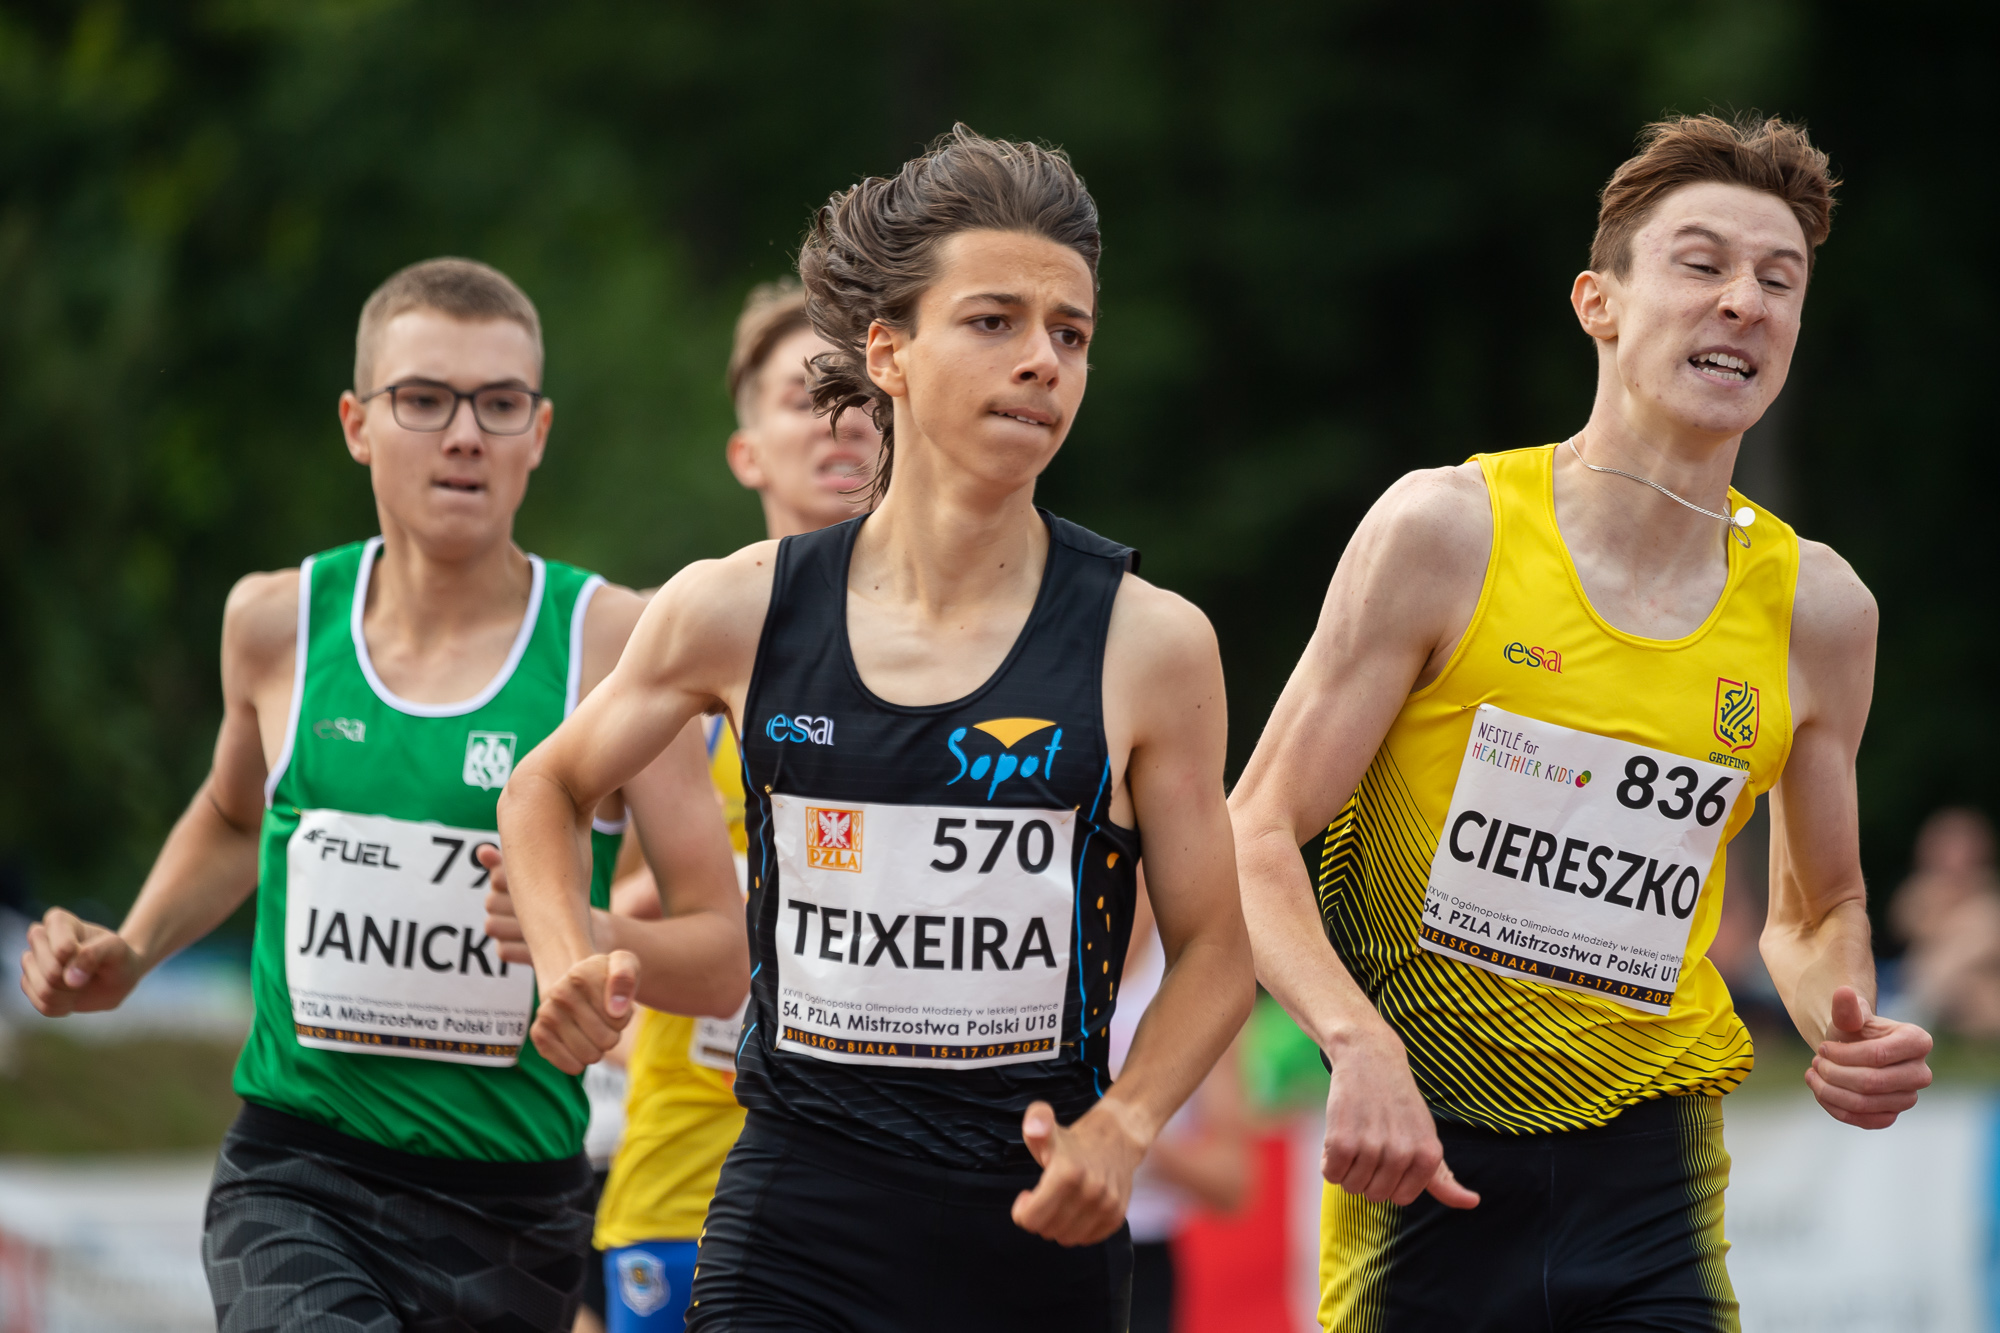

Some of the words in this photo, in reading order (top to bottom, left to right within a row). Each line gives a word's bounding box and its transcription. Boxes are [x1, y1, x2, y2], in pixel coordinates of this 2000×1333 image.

[766, 713, 835, 746] esa
[1523, 740, 1539, 755] for
[946, 727, 1063, 801] Sopot
[1472, 742, 1541, 778] HEALTHIER
[1545, 764, 1574, 784] KIDS
[1708, 751, 1750, 770] GRYFINO
[1616, 755, 1734, 827] 836
[321, 838, 402, 870] FUEL
[808, 851, 859, 870] PZLA
[929, 818, 1055, 875] 570
[1449, 810, 1700, 920] CIERESZKO
[788, 898, 1057, 971] TEIXEIRA
[1423, 897, 1441, 920] 54.
[1448, 910, 1491, 938] PZLA
[1496, 926, 1602, 966] Mistrzostwa
[1606, 954, 1658, 979] Polski
[1451, 897, 1518, 925] Ogólnopolska
[1520, 918, 1570, 938] Olimpiada
[1572, 932, 1618, 951] Młodzieży
[1630, 946, 1658, 960] lekkiej
[782, 1001, 802, 1020] 54.
[807, 1006, 841, 1029] PZLA
[847, 1014, 960, 1036] Mistrzostwa
[967, 1017, 1019, 1036] Polski
[1025, 1014, 1057, 1032] U18
[804, 993, 862, 1011] Ogólnopolska
[865, 1002, 919, 1015] Olimpiada
[976, 1008, 985, 1016] w
[987, 1006, 1017, 1016] lekkiej
[1020, 1002, 1058, 1015] atletyce
[786, 1028, 898, 1055] BIELSKO-BIAŁA
[931, 1040, 1050, 1058] 15-17.07.2022
